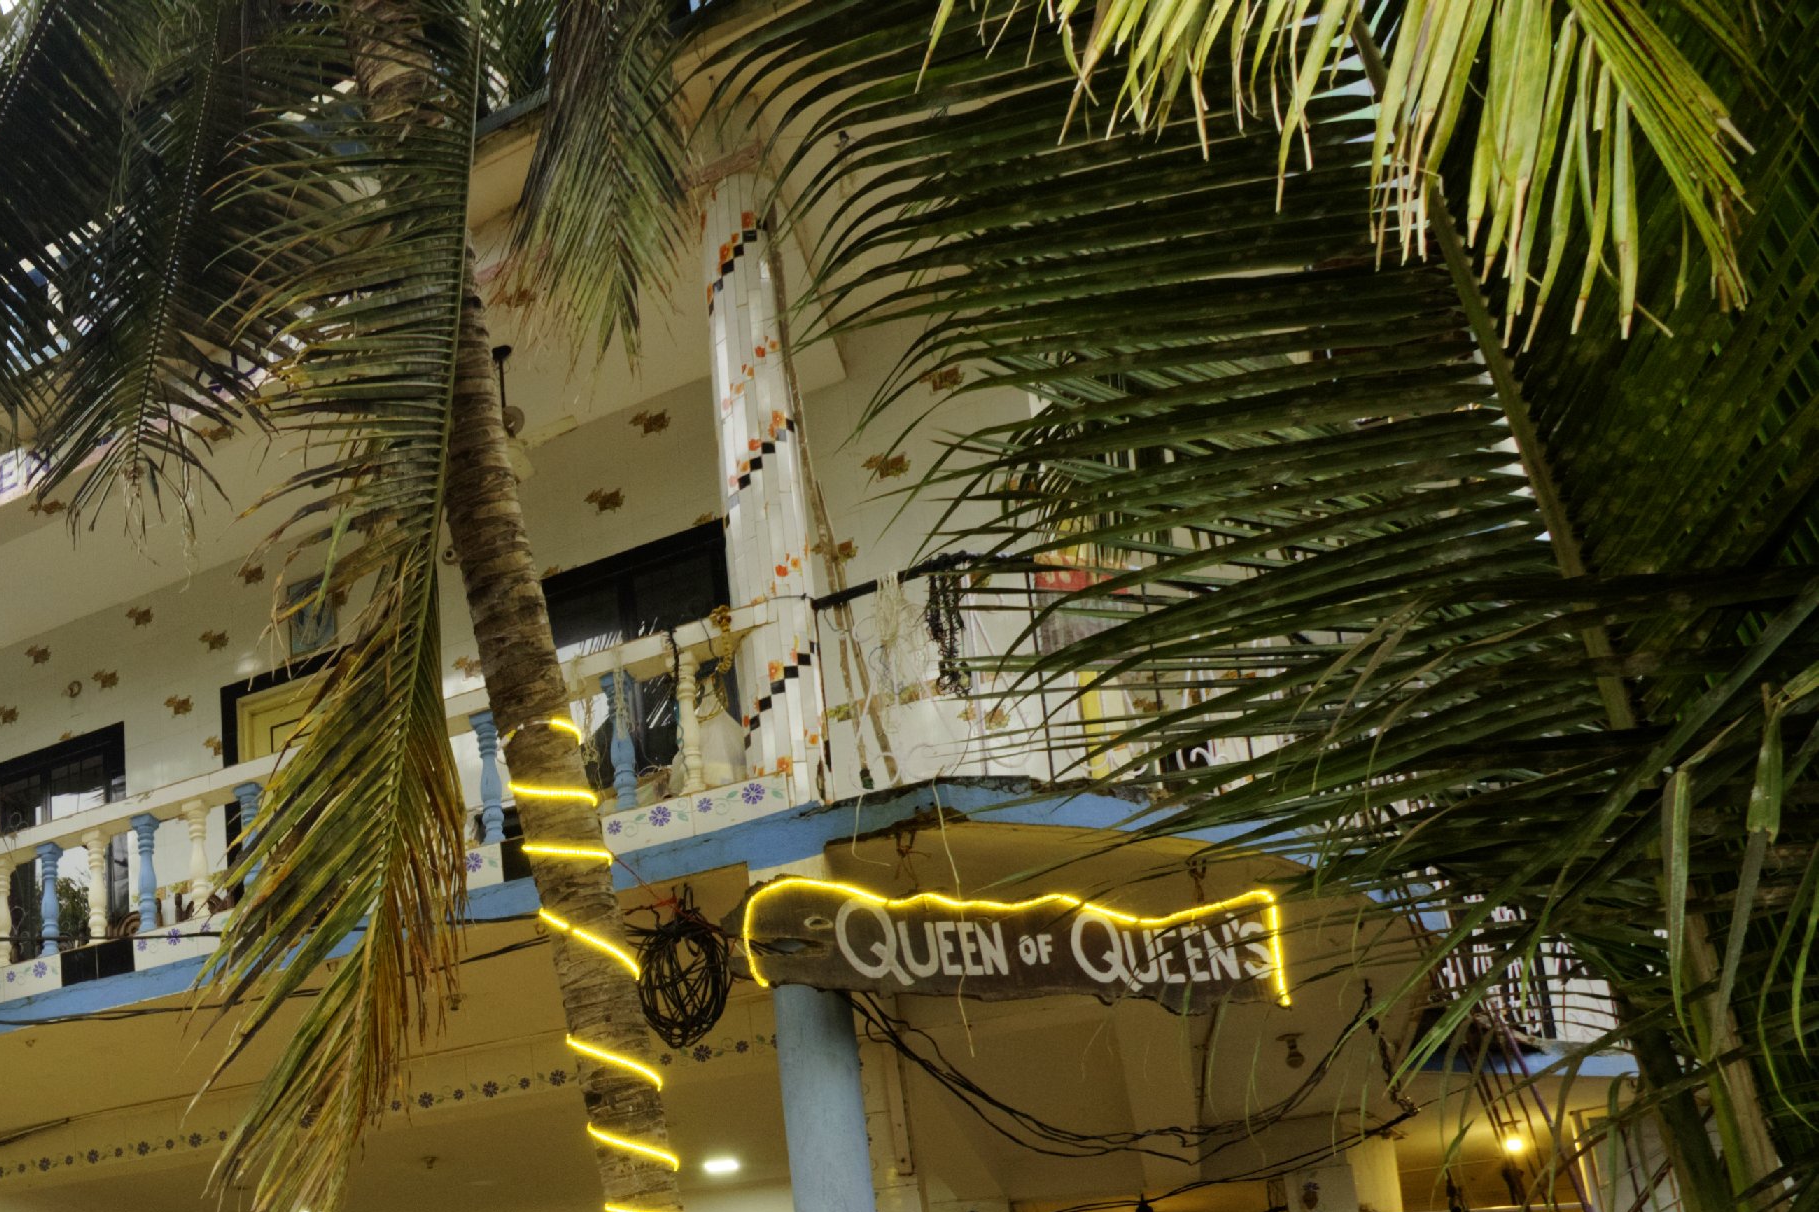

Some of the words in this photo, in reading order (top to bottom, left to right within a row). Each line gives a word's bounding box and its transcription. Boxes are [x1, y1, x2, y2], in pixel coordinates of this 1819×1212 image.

[834, 898, 1009, 985] QUEEN
[1019, 933, 1052, 965] OF
[1070, 911, 1274, 992] QUEEN'S
